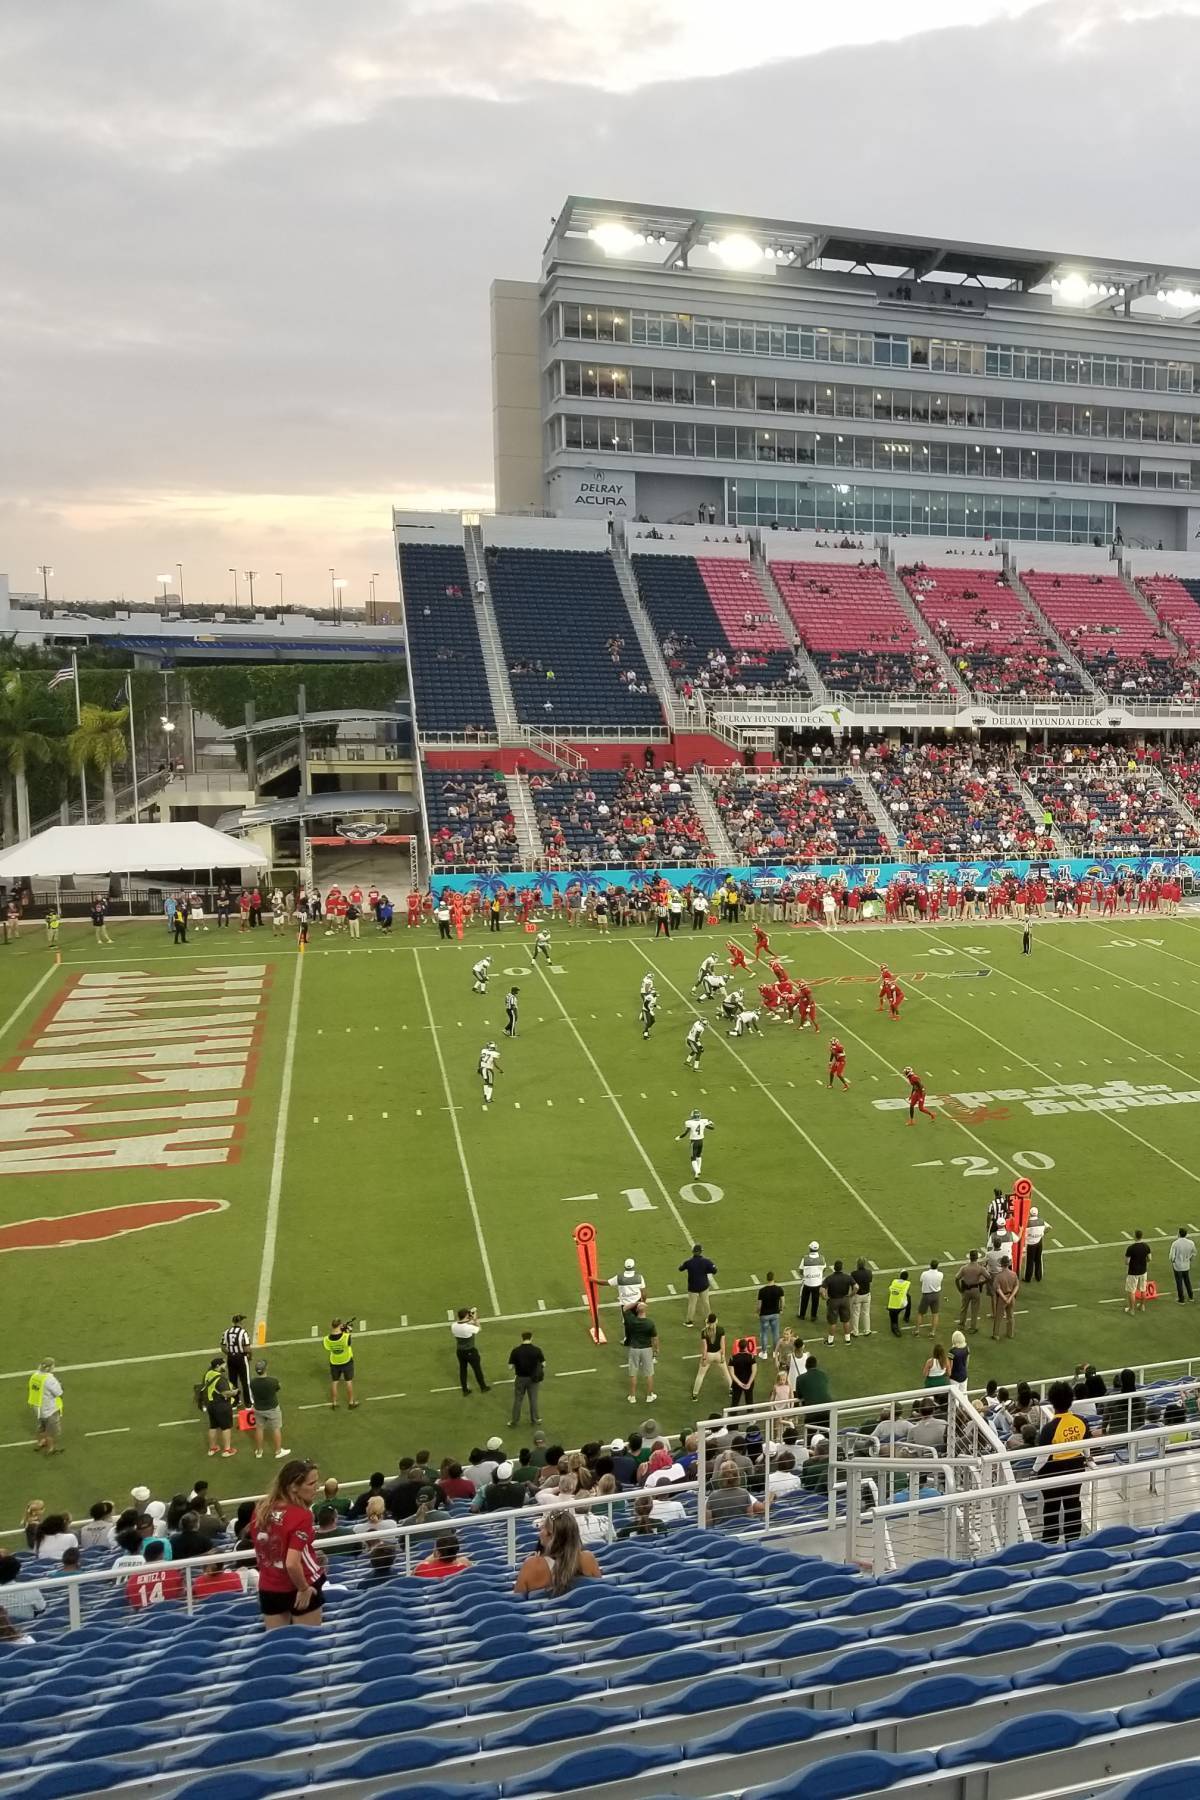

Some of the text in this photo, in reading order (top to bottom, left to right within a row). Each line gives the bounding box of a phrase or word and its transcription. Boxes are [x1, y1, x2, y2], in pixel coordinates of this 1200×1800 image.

[580, 483, 623, 494] DELRAY
[575, 495, 627, 506] ACURA
[754, 714, 799, 724] HYUNDAI
[800, 715, 825, 724] DECK
[992, 717, 1103, 727] DELRAY HYUNDAI DECK
[0, 964, 270, 1175] ATLANTIC
[950, 1150, 1057, 1177] 20
[619, 1182, 725, 1212] 10
[229, 1333, 237, 1345] F
[1063, 1425, 1080, 1437] CSC
[138, 1582, 165, 1607] 14
